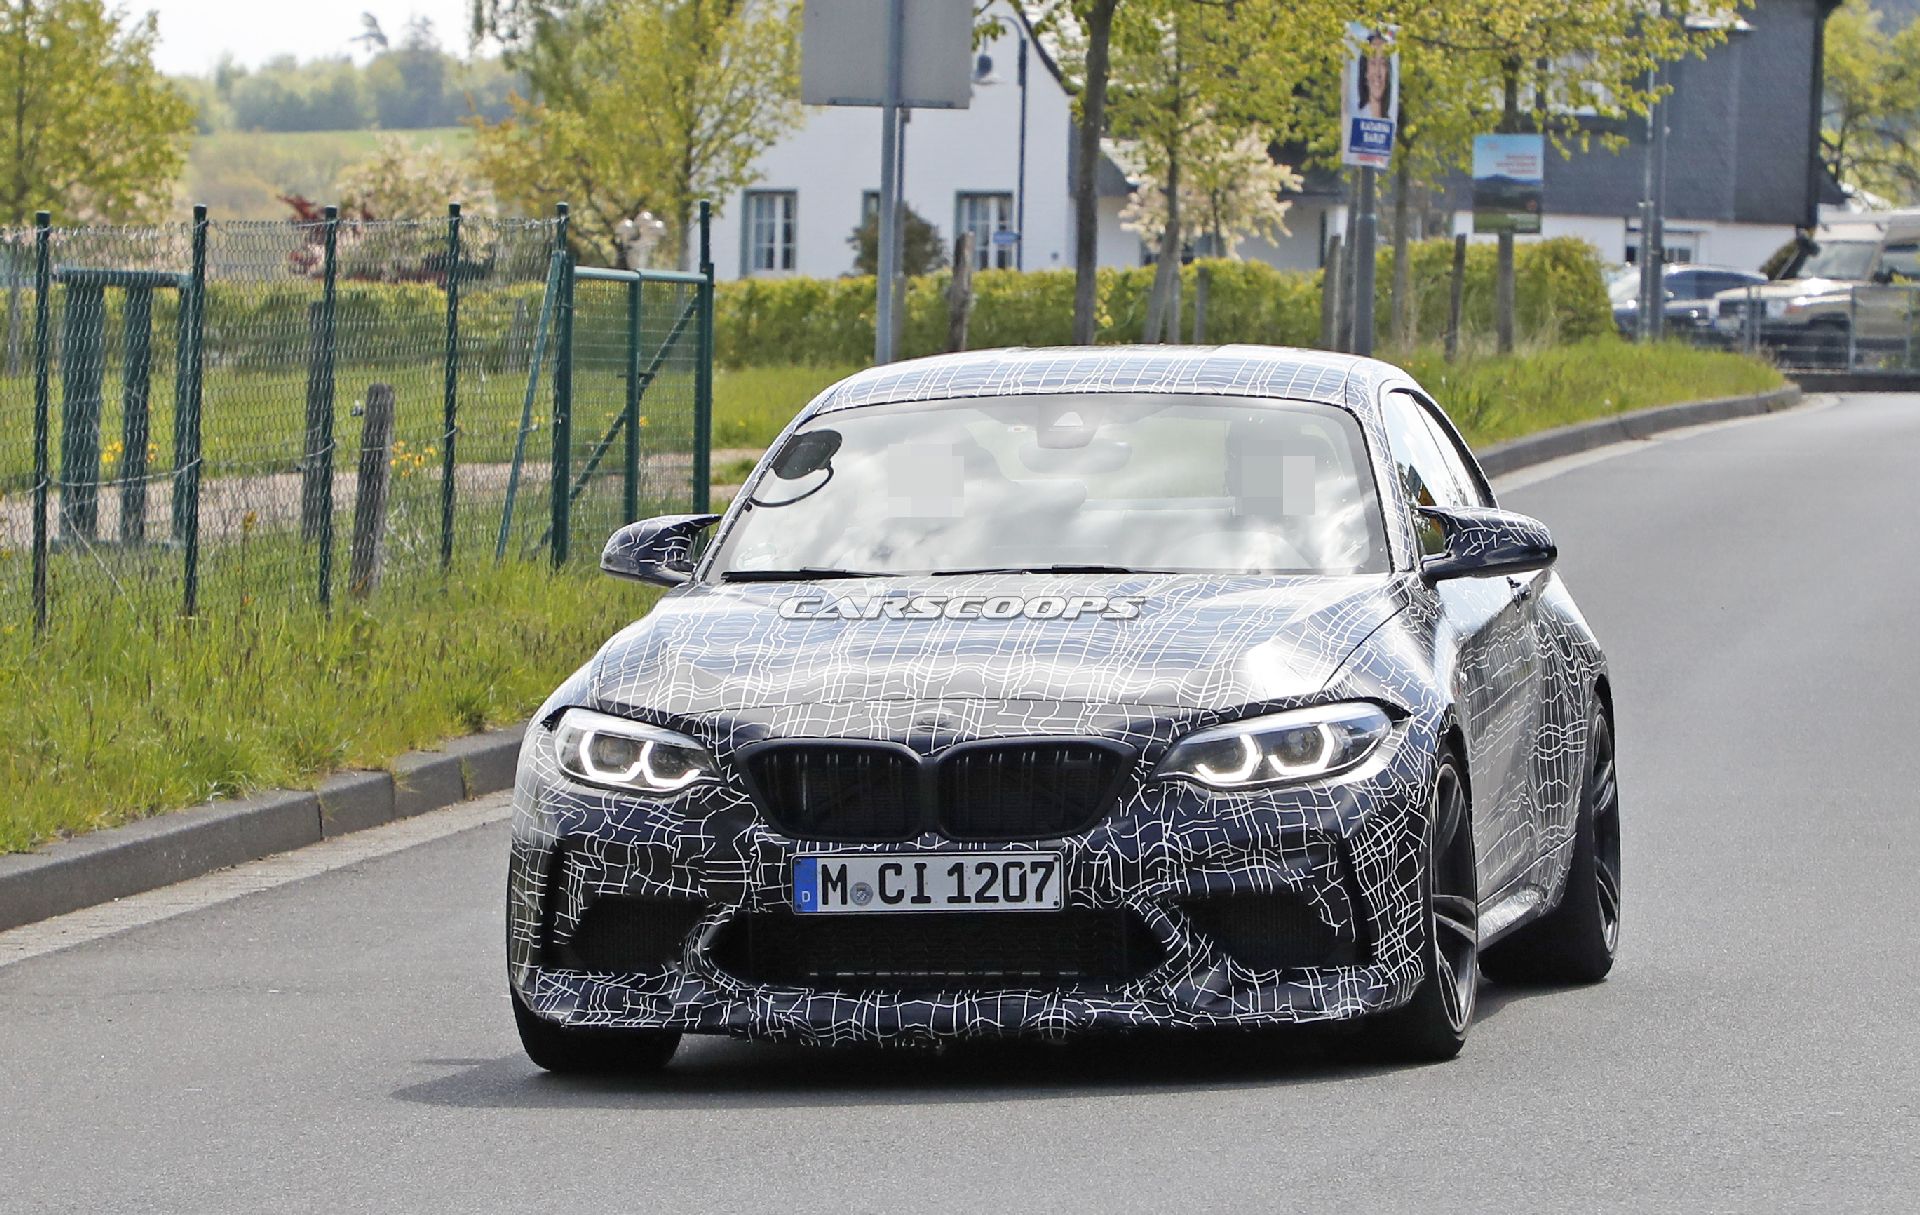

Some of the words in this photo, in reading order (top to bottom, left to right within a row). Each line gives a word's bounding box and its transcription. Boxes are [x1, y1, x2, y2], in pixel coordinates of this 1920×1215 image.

[802, 890, 811, 903] D
[820, 864, 848, 905] M
[878, 862, 931, 904] CI
[947, 861, 1055, 904] 1207
